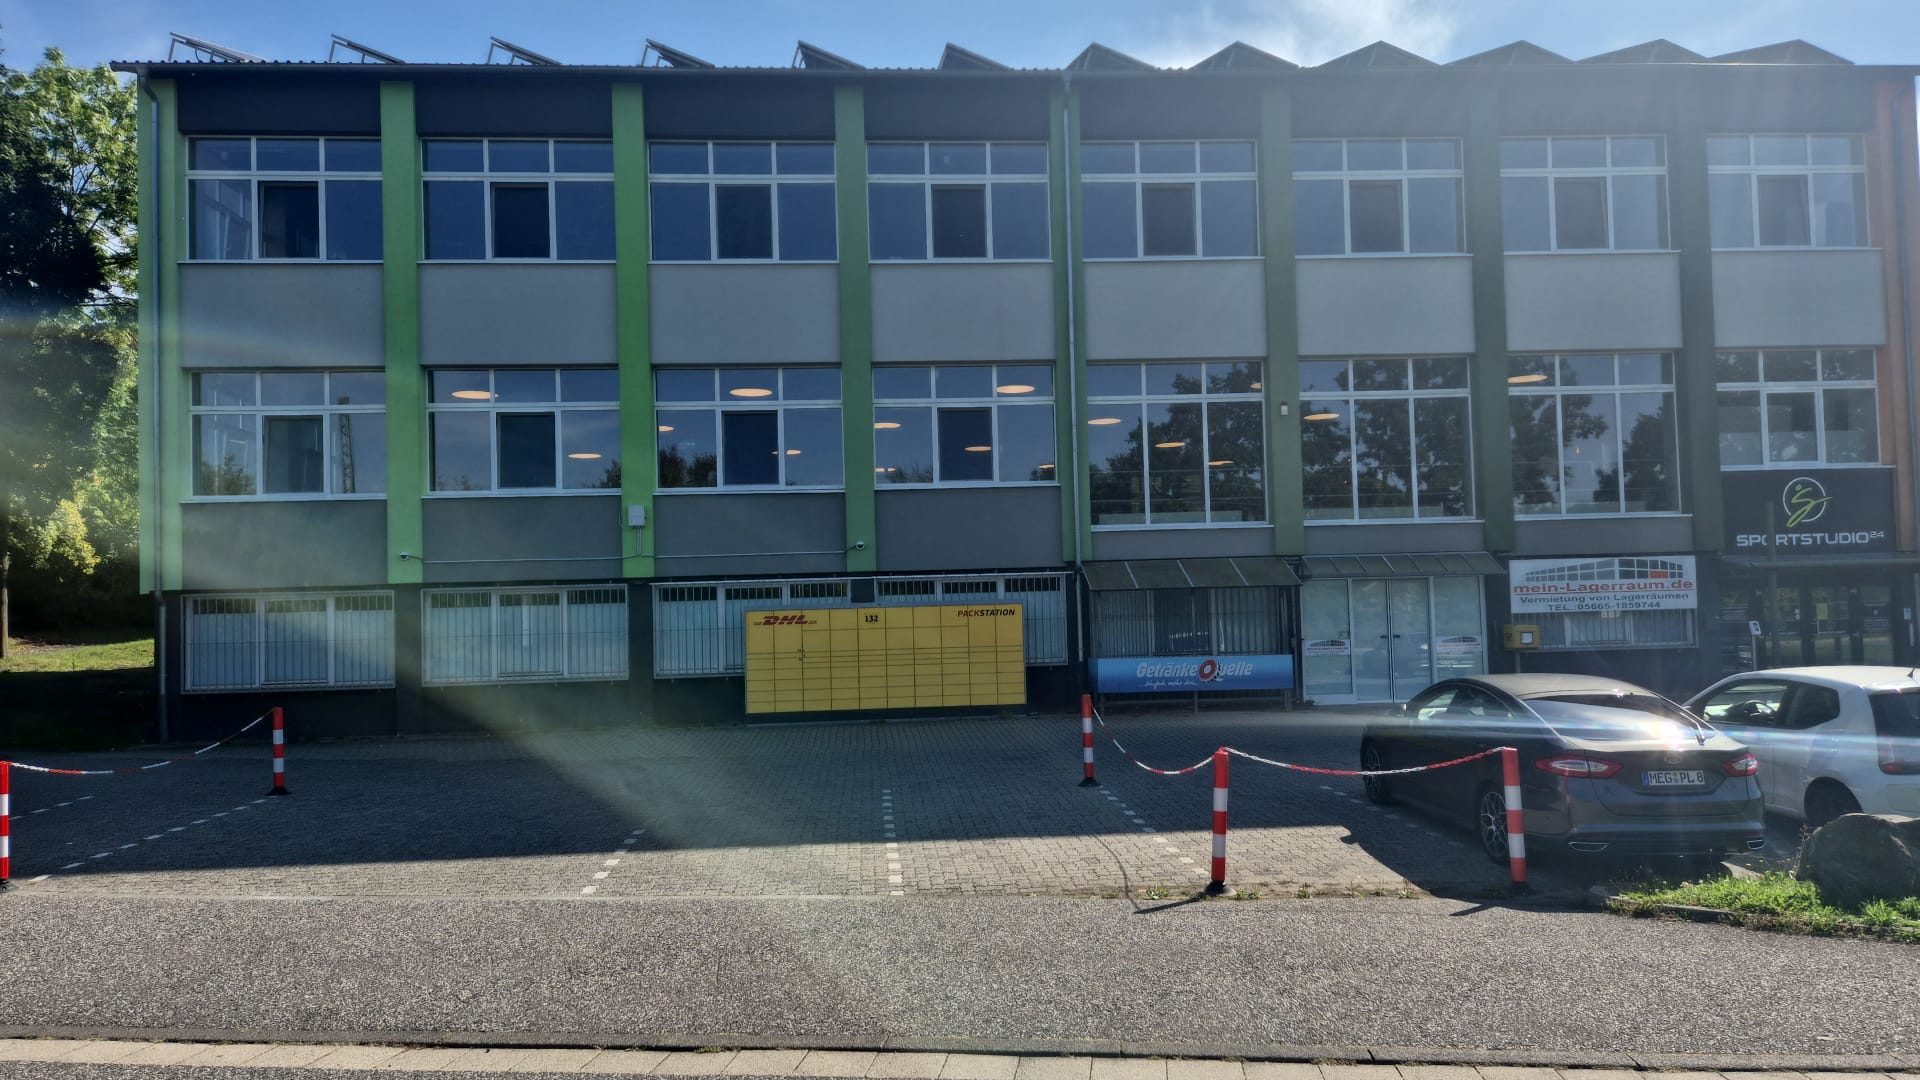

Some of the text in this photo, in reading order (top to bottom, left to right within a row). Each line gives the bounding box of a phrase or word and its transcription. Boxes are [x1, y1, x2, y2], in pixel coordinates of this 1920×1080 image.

[1513, 579, 1694, 594] mein-Lagerraum.de
[1519, 596, 1586, 605] Vermietung
[1613, 592, 1689, 602] Lagerräumen
[865, 615, 879, 623] 132
[957, 609, 1015, 617] PACKSTATION
[763, 615, 808, 625] DHL
[1137, 662, 1198, 678] Getränke
[1649, 771, 1704, 784] MEG PL 8
